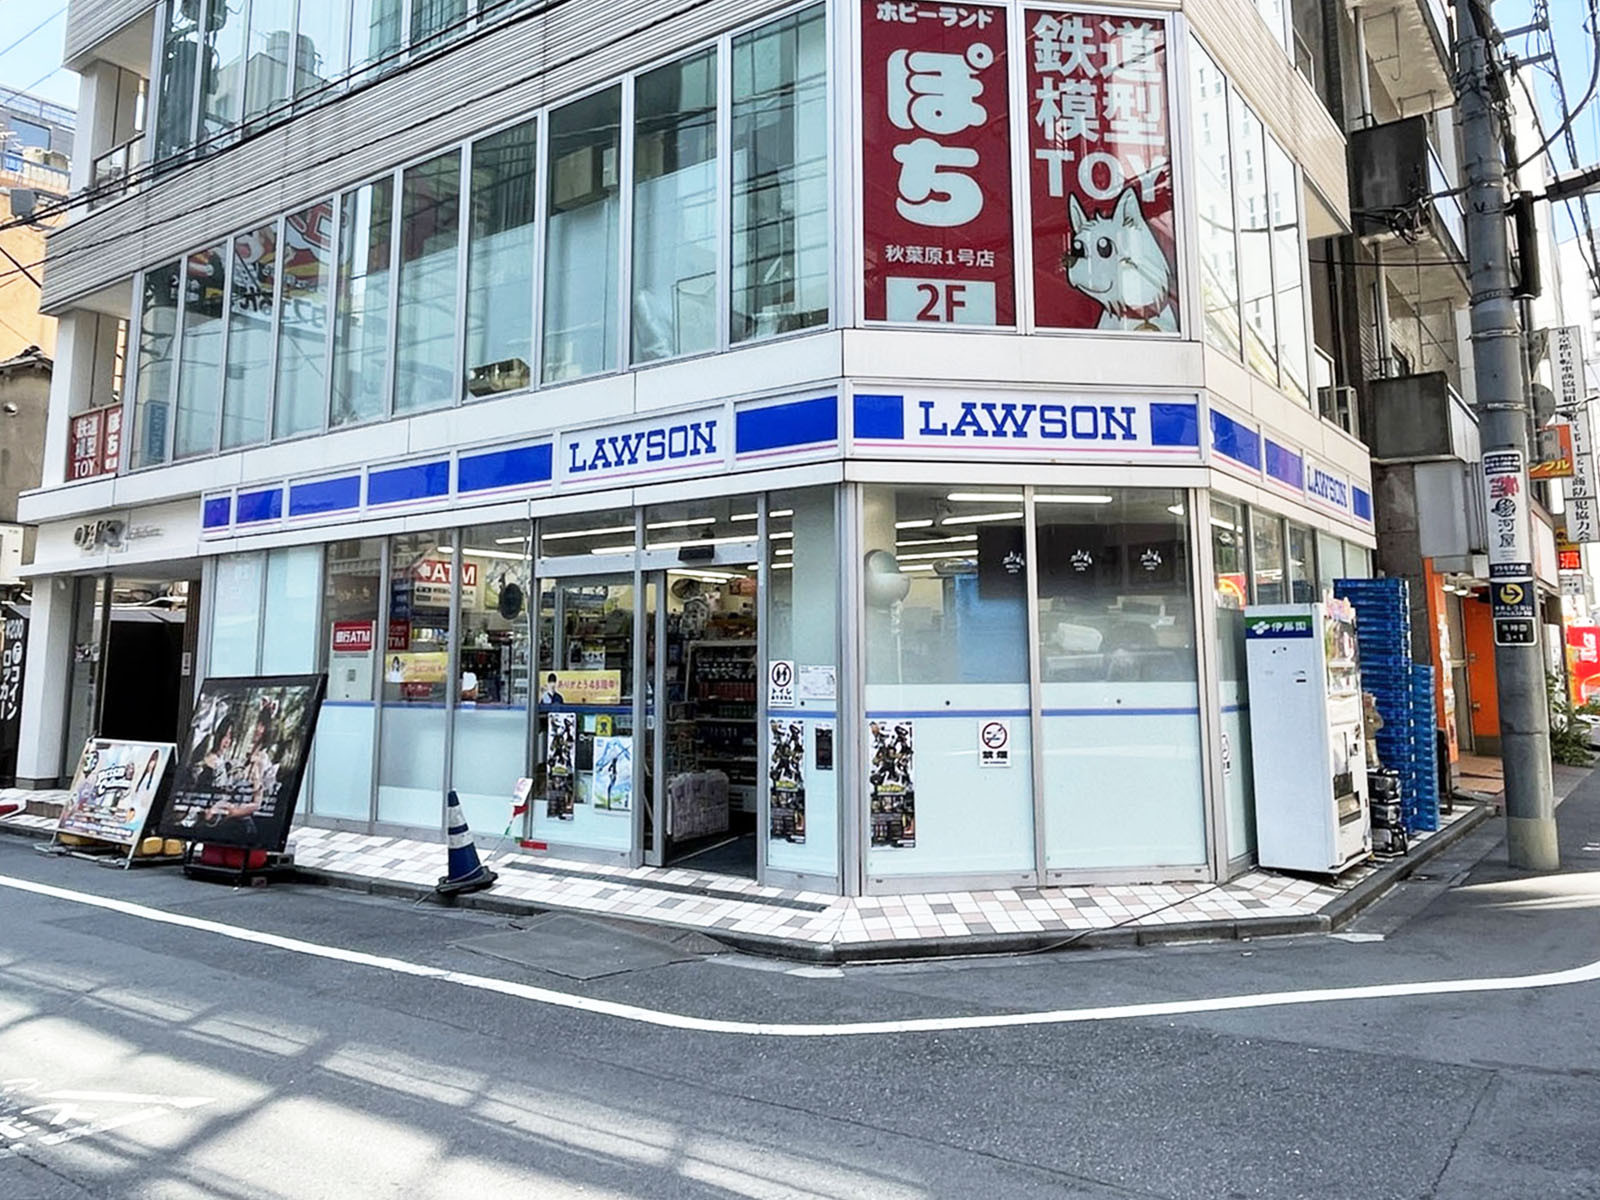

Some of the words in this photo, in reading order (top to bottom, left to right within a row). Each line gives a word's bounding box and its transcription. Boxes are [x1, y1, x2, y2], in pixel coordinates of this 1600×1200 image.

[877, 1, 994, 29] ホビーランド
[1032, 15, 1164, 83] 鉄道
[1035, 77, 1164, 145] 模型
[887, 42, 994, 227] ぽち
[1035, 149, 1171, 203] TOY
[885, 244, 995, 267] 秋葉原1号店
[916, 284, 966, 321] 2F
[919, 401, 1137, 440] LAWSON
[569, 420, 717, 473] LAWSON
[74, 459, 95, 478] TOY
[1307, 465, 1347, 508] LAWSON
